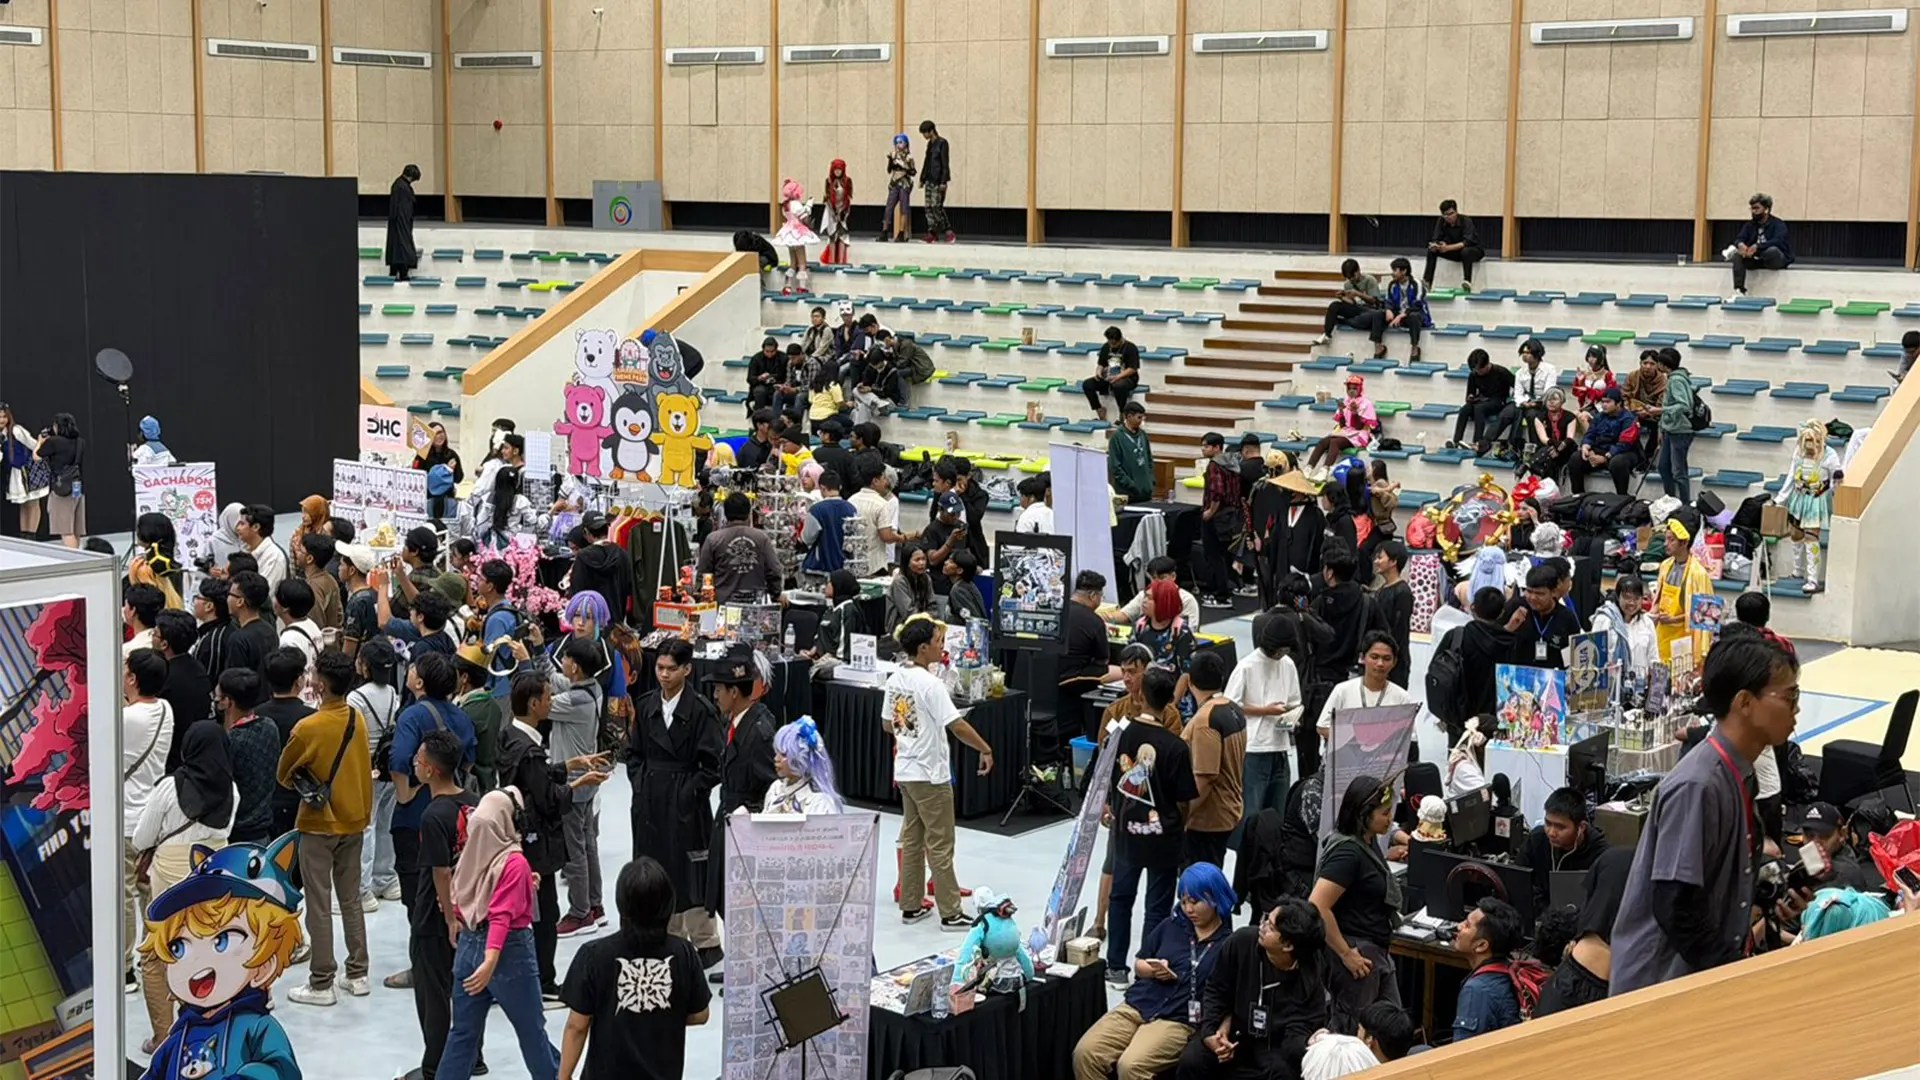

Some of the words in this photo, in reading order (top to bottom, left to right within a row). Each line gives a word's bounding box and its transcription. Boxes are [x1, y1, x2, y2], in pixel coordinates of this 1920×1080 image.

[366, 417, 401, 437] DHC
[143, 476, 212, 488] GACHAPON
[37, 828, 68, 862] FIND
